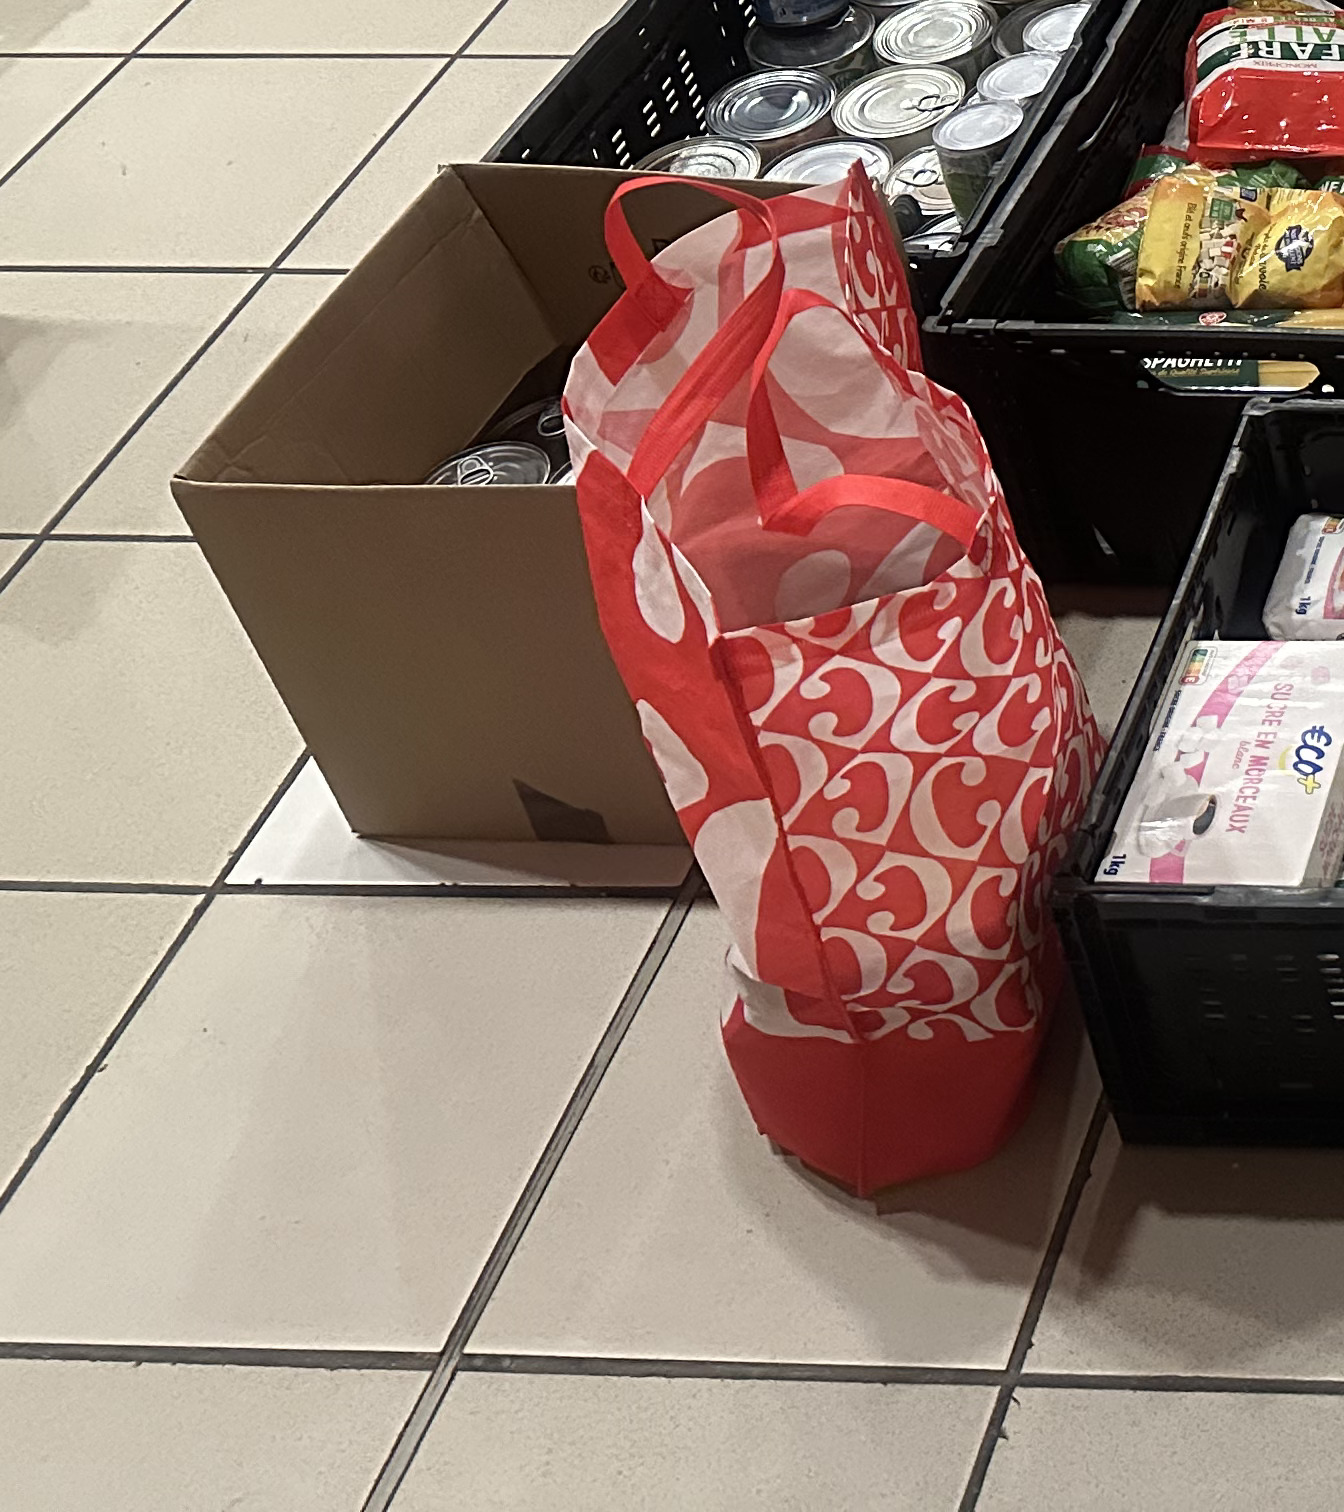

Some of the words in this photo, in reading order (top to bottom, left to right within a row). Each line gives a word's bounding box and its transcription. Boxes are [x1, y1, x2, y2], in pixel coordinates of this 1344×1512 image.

[1261, 682, 1294, 727] SUCRE
[1253, 731, 1278, 750] EN
[1225, 753, 1272, 835] MORCEAUX
